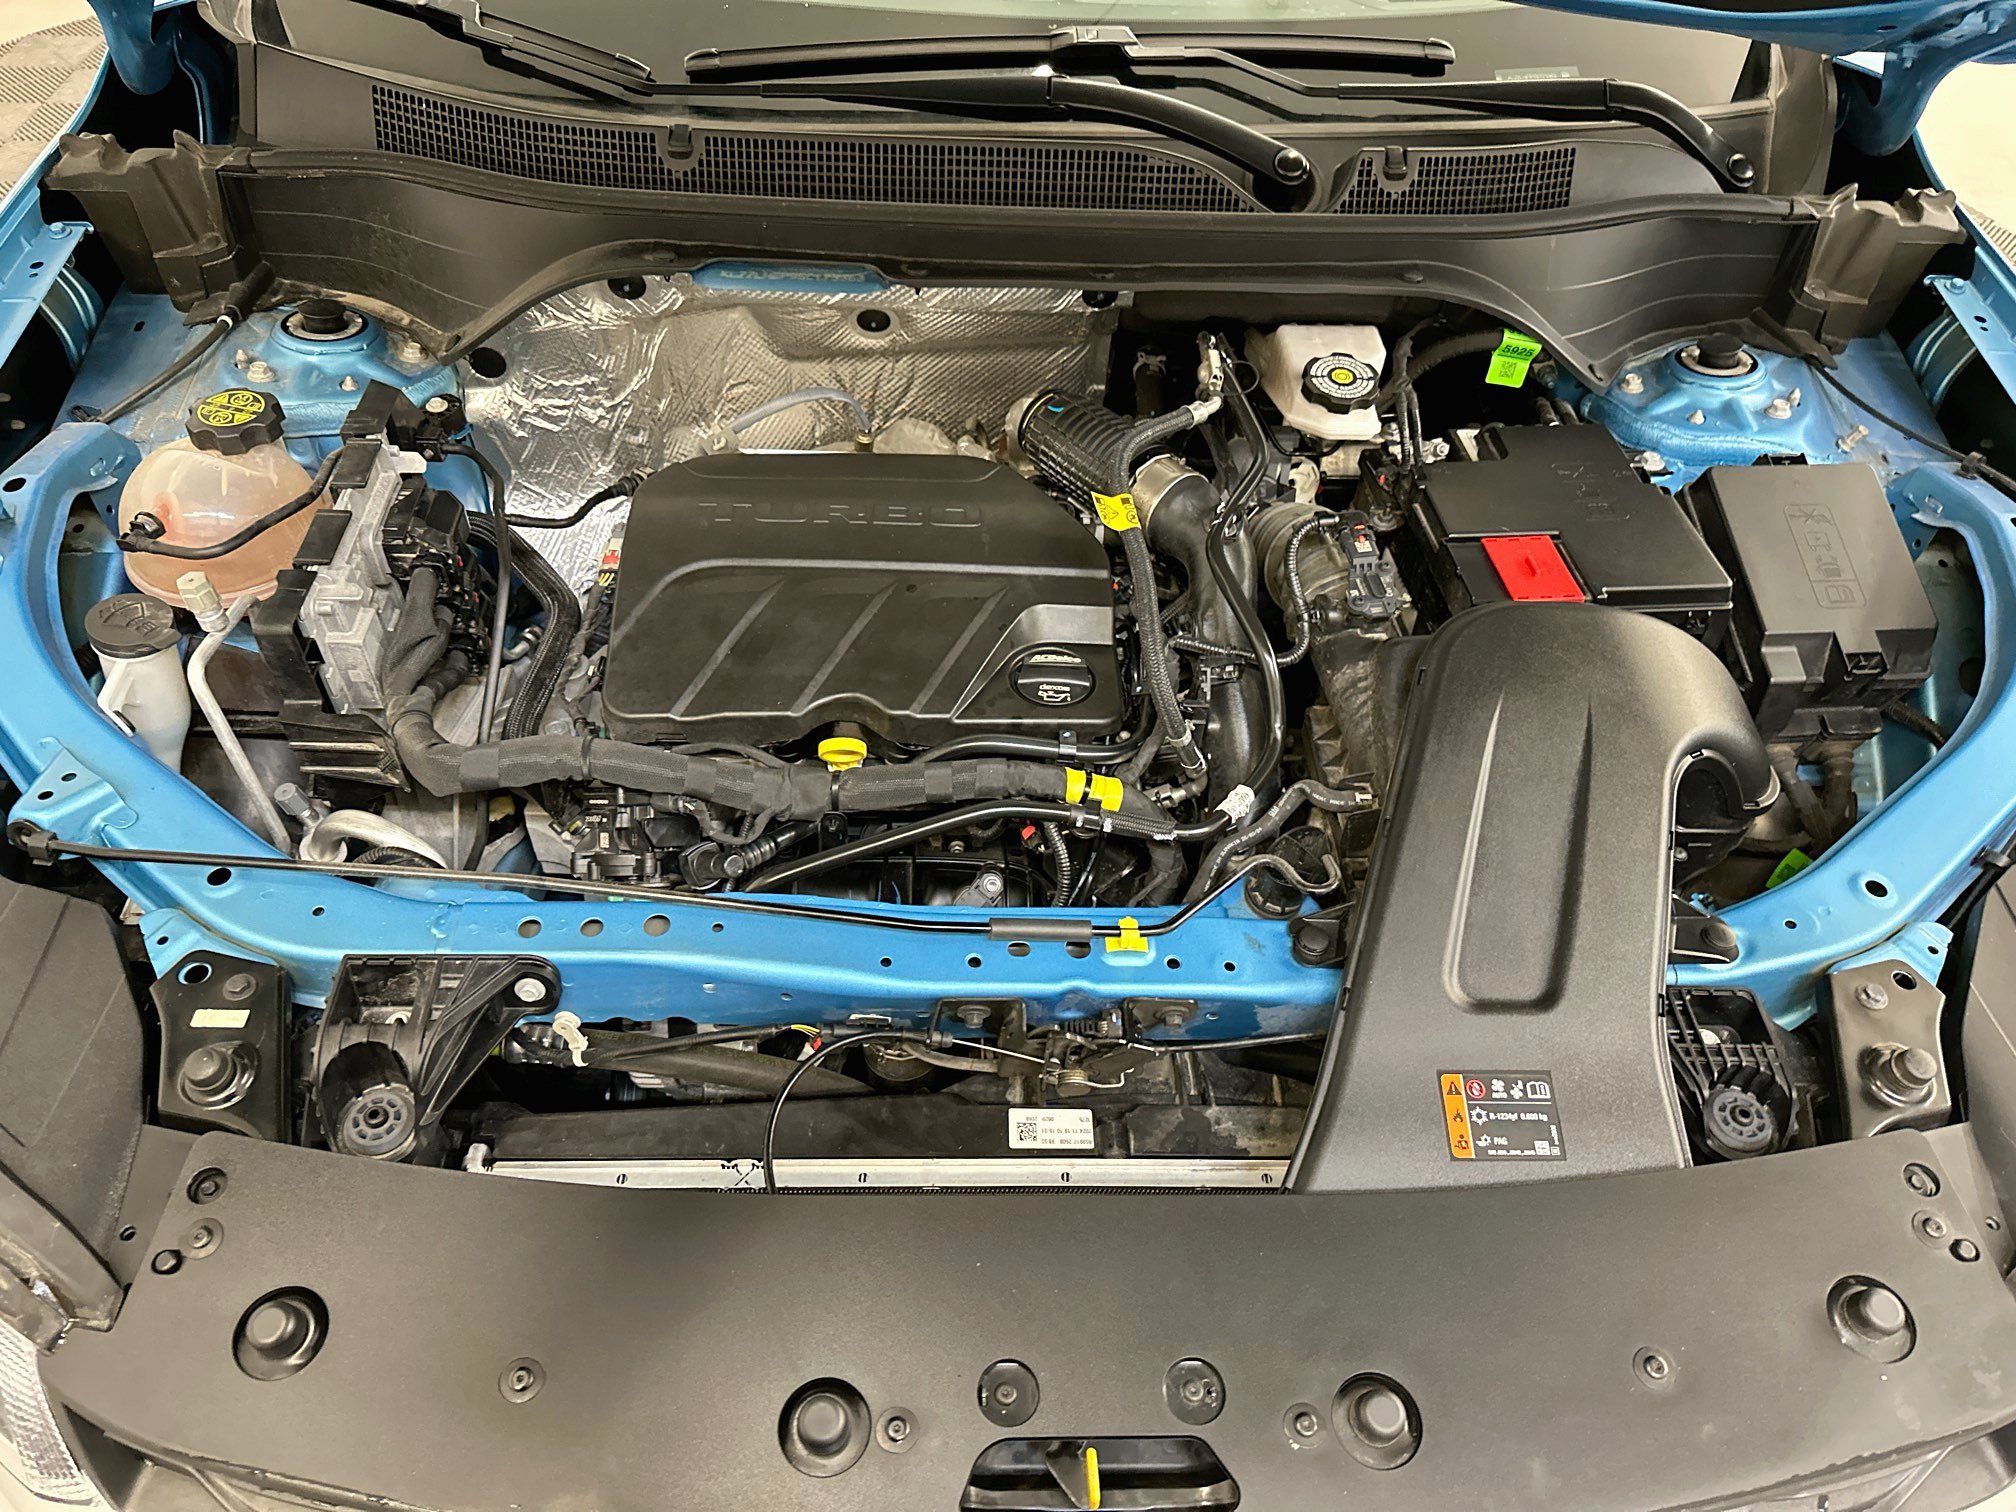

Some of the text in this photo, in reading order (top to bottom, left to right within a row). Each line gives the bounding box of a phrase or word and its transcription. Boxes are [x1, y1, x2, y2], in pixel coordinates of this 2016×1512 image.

[1502, 345, 1535, 357] 5925
[699, 503, 981, 527] TURBO
[1493, 1136, 1508, 1145] PAG
